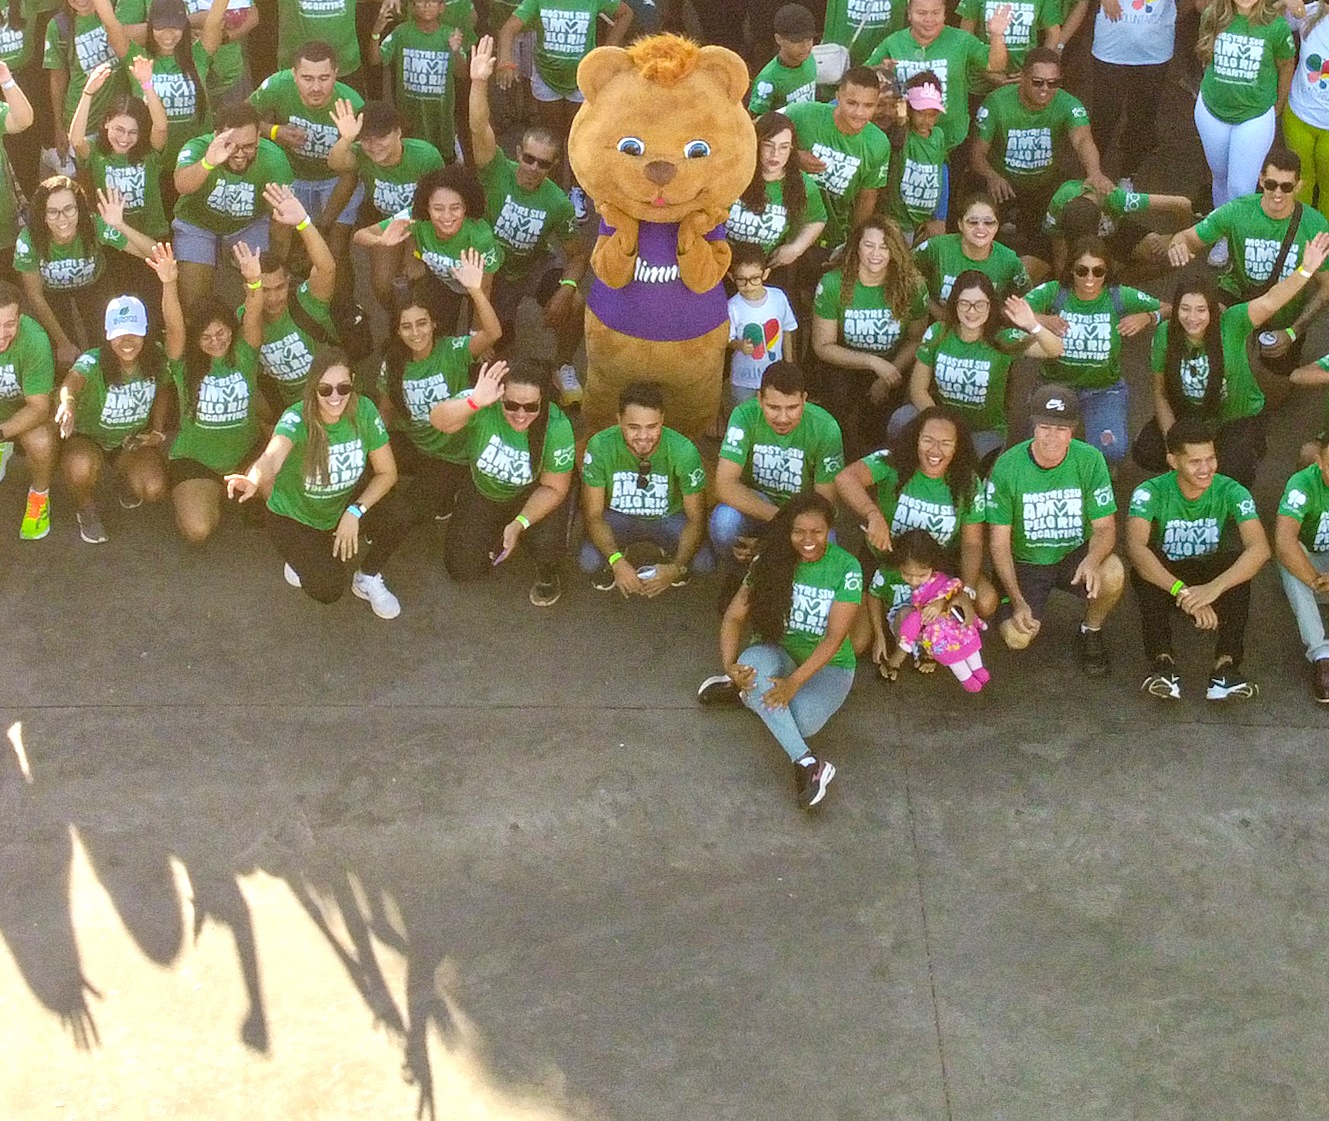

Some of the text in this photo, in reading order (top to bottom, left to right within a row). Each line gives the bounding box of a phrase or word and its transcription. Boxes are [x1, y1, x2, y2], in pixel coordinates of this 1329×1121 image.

[1214, 53, 1239, 70] PELO
[937, 380, 963, 393] PELO
[1024, 516, 1056, 531] PELO
